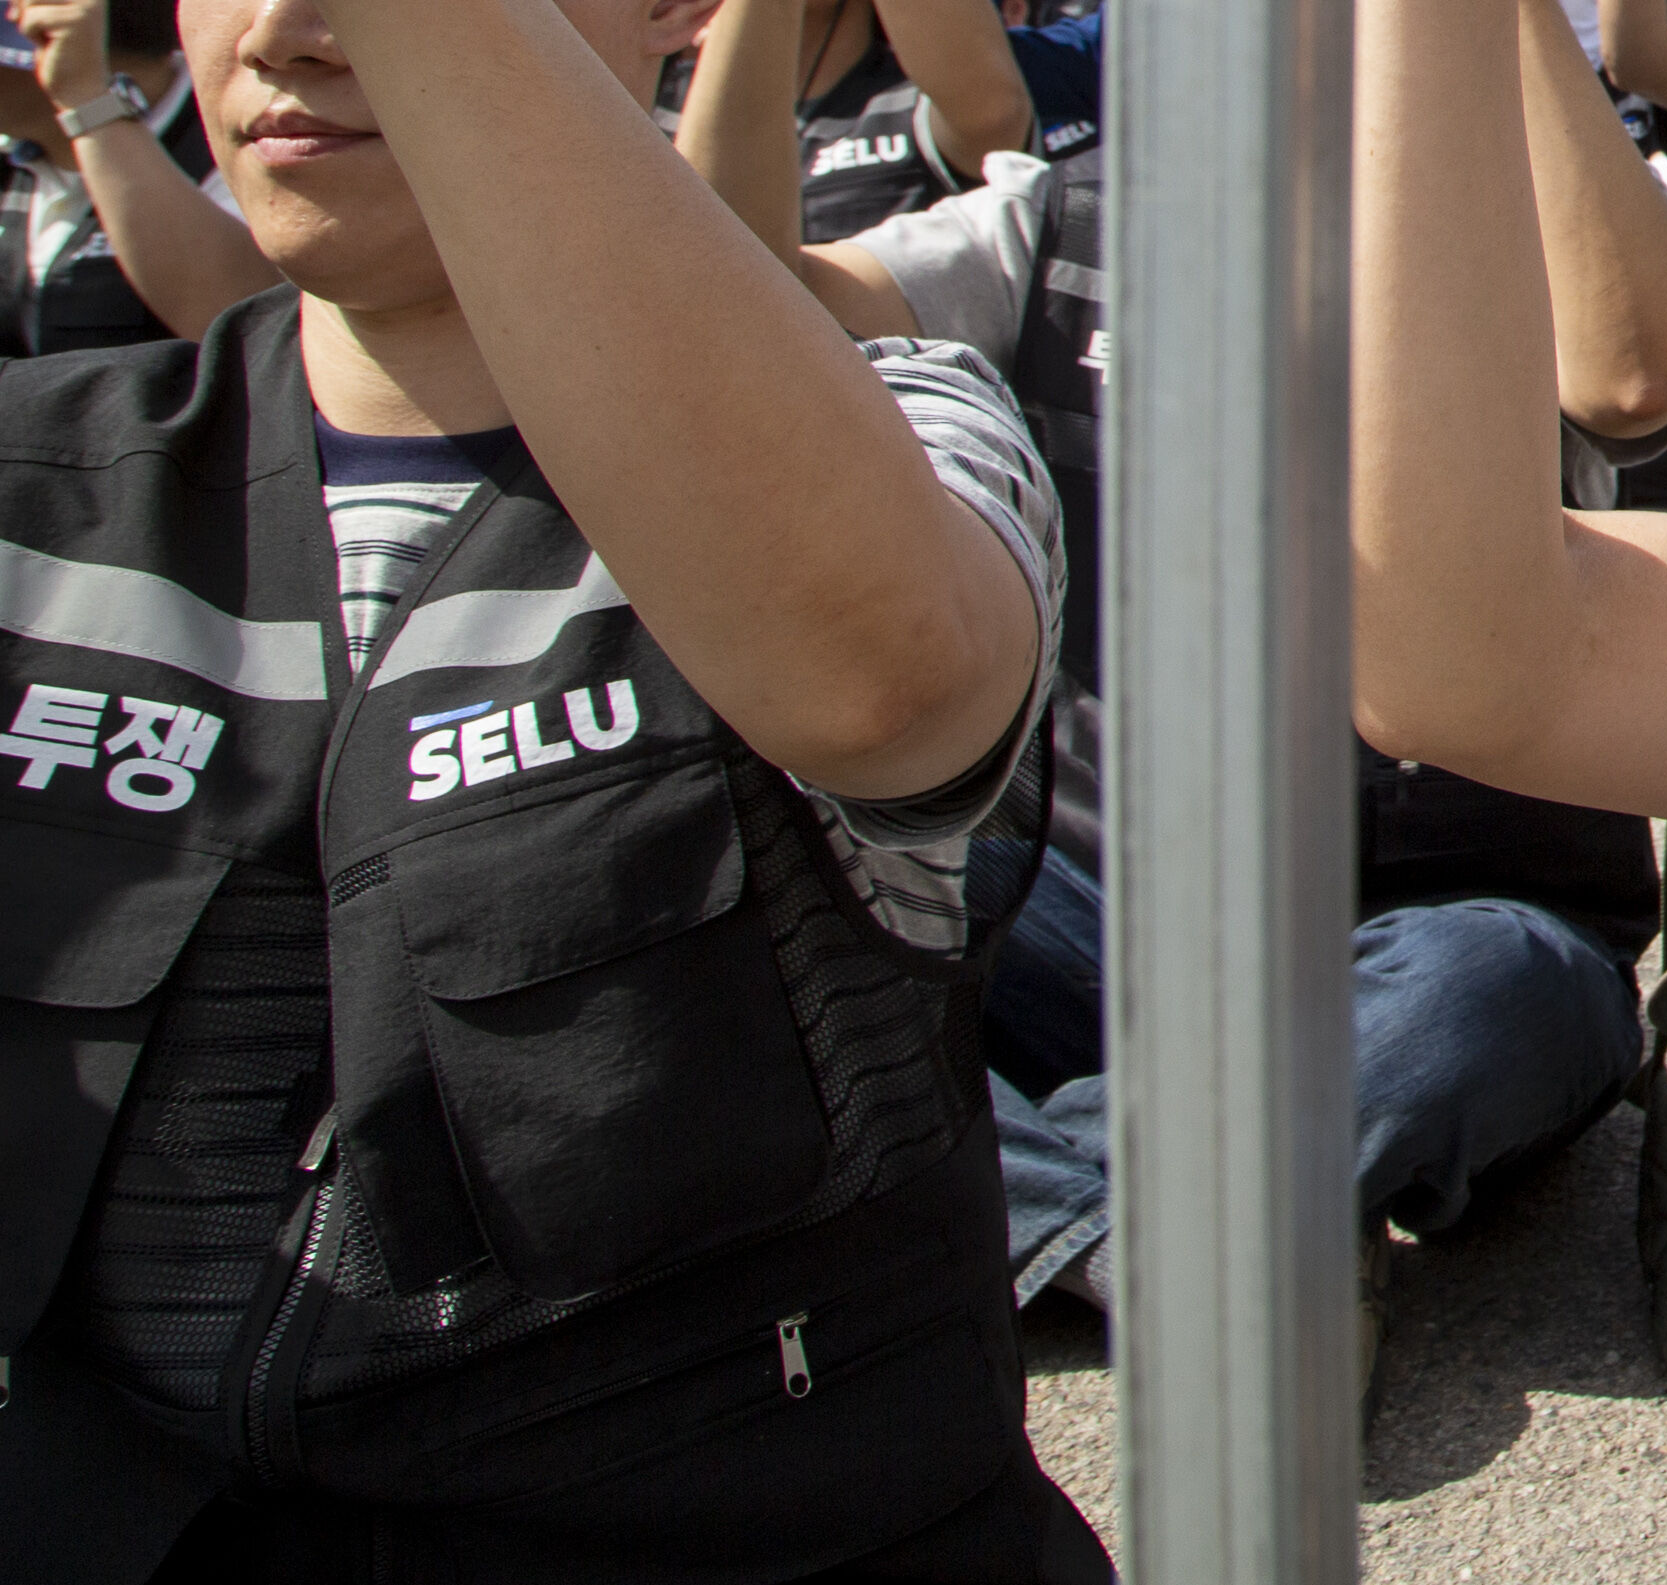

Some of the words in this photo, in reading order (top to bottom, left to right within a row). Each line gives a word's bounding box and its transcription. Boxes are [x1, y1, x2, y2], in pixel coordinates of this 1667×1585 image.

[809, 134, 908, 176] SELU
[0, 683, 225, 812] 투쟁
[408, 679, 640, 801] SELU
